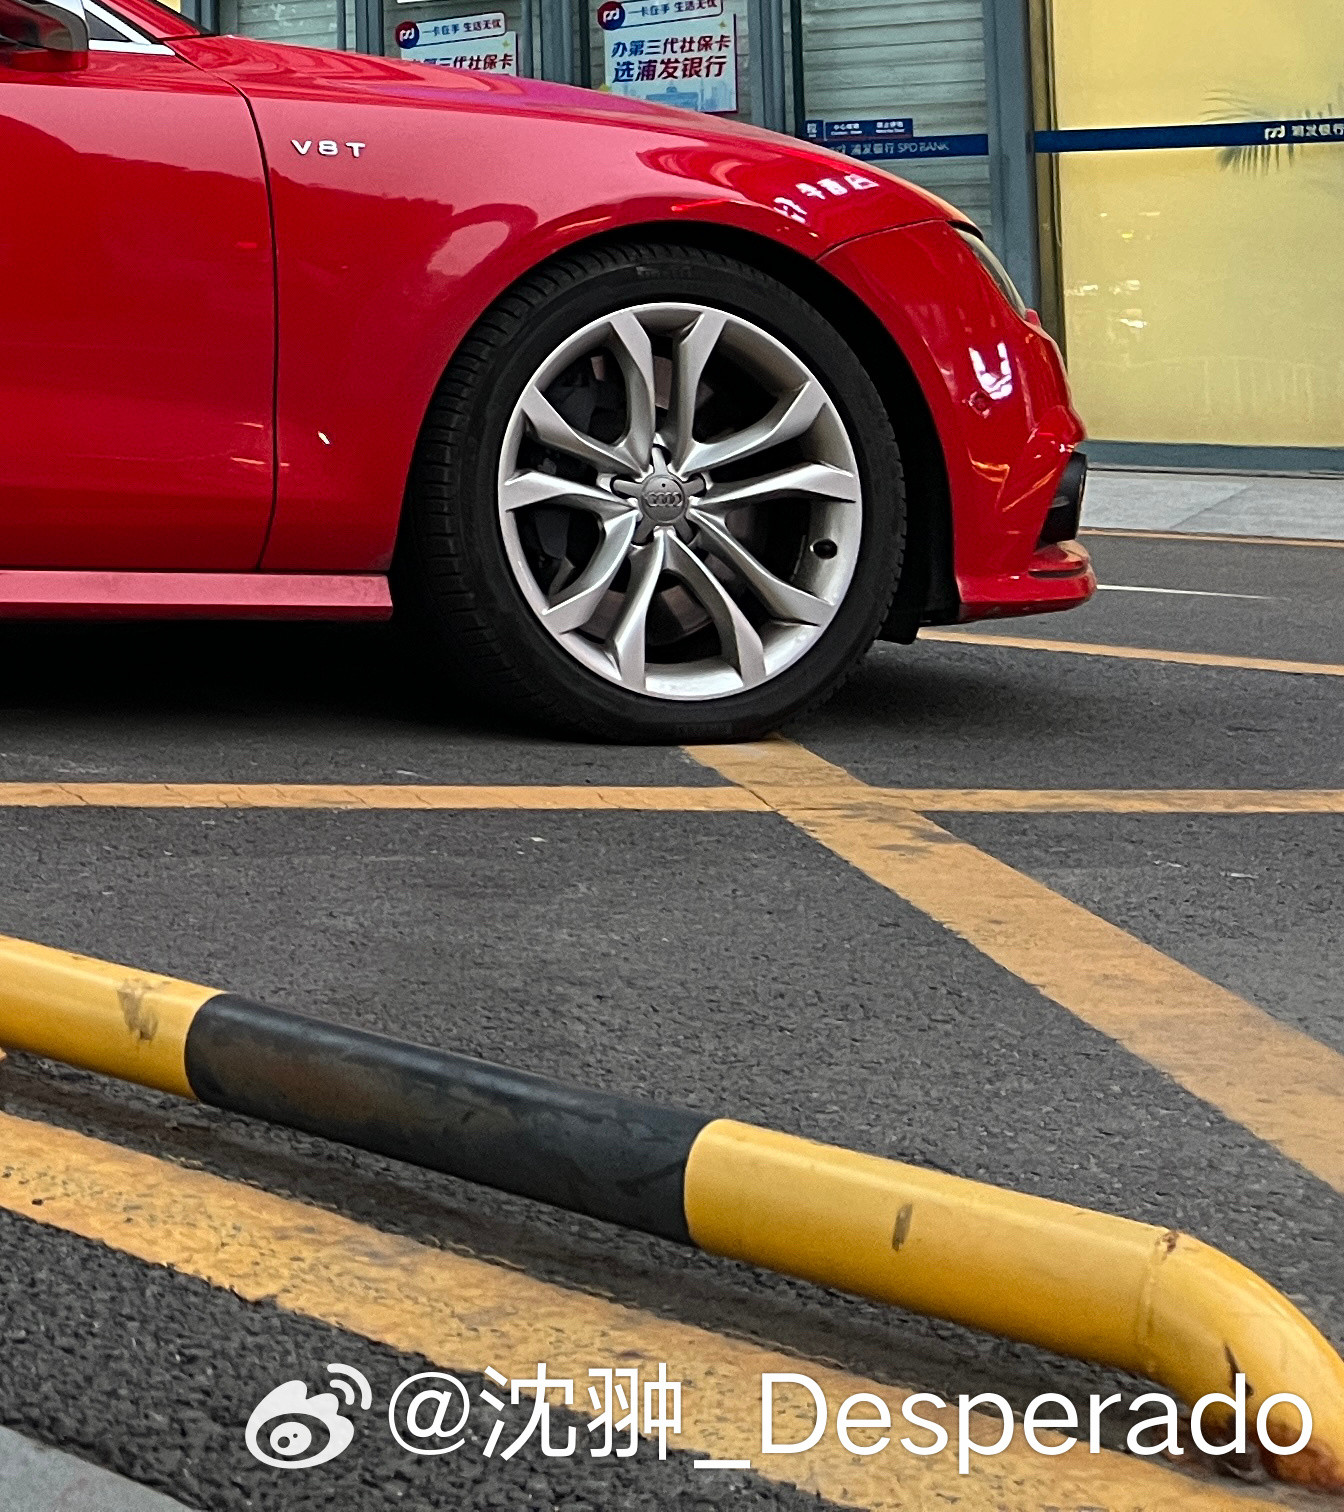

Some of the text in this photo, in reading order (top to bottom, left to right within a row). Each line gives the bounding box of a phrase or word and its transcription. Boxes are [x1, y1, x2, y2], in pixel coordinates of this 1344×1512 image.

[628, 2, 670, 18] 一卡在手
[611, 34, 732, 58] 办第三代社保卡
[612, 55, 728, 84] 选浦发银行
[898, 141, 918, 154] SPD
[919, 140, 951, 153] BANK
